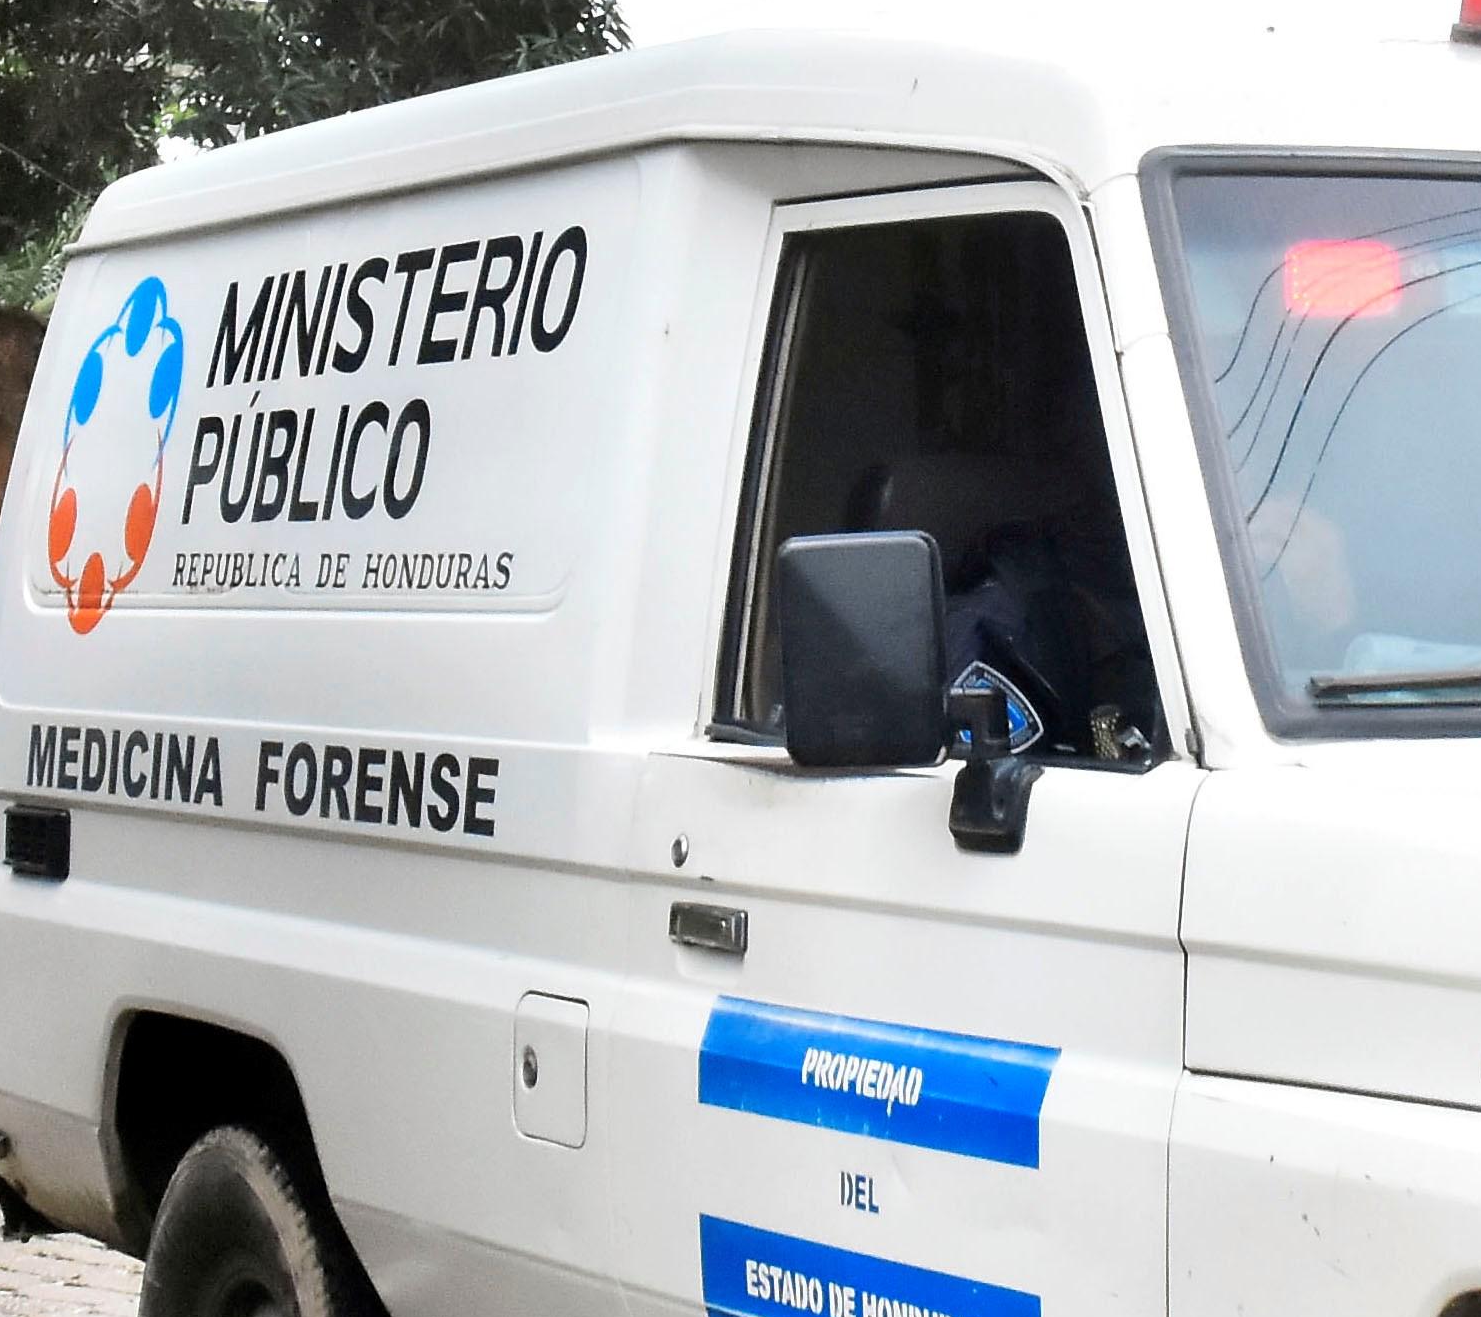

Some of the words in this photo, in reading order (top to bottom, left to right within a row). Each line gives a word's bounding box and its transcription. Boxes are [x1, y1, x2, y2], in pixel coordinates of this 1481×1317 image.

[206, 225, 588, 389] MINISTERIO
[181, 391, 432, 525] PÚBLICO
[173, 551, 302, 588] REPUBLICA
[316, 553, 350, 588] DE
[361, 551, 516, 592] HONDURAS
[27, 724, 224, 808] MEDICINA
[254, 740, 501, 838] FORENSE
[801, 1046, 924, 1111] PROPIEDAD
[839, 1169, 880, 1214] DEL
[745, 1259, 824, 1315] ESTADO
